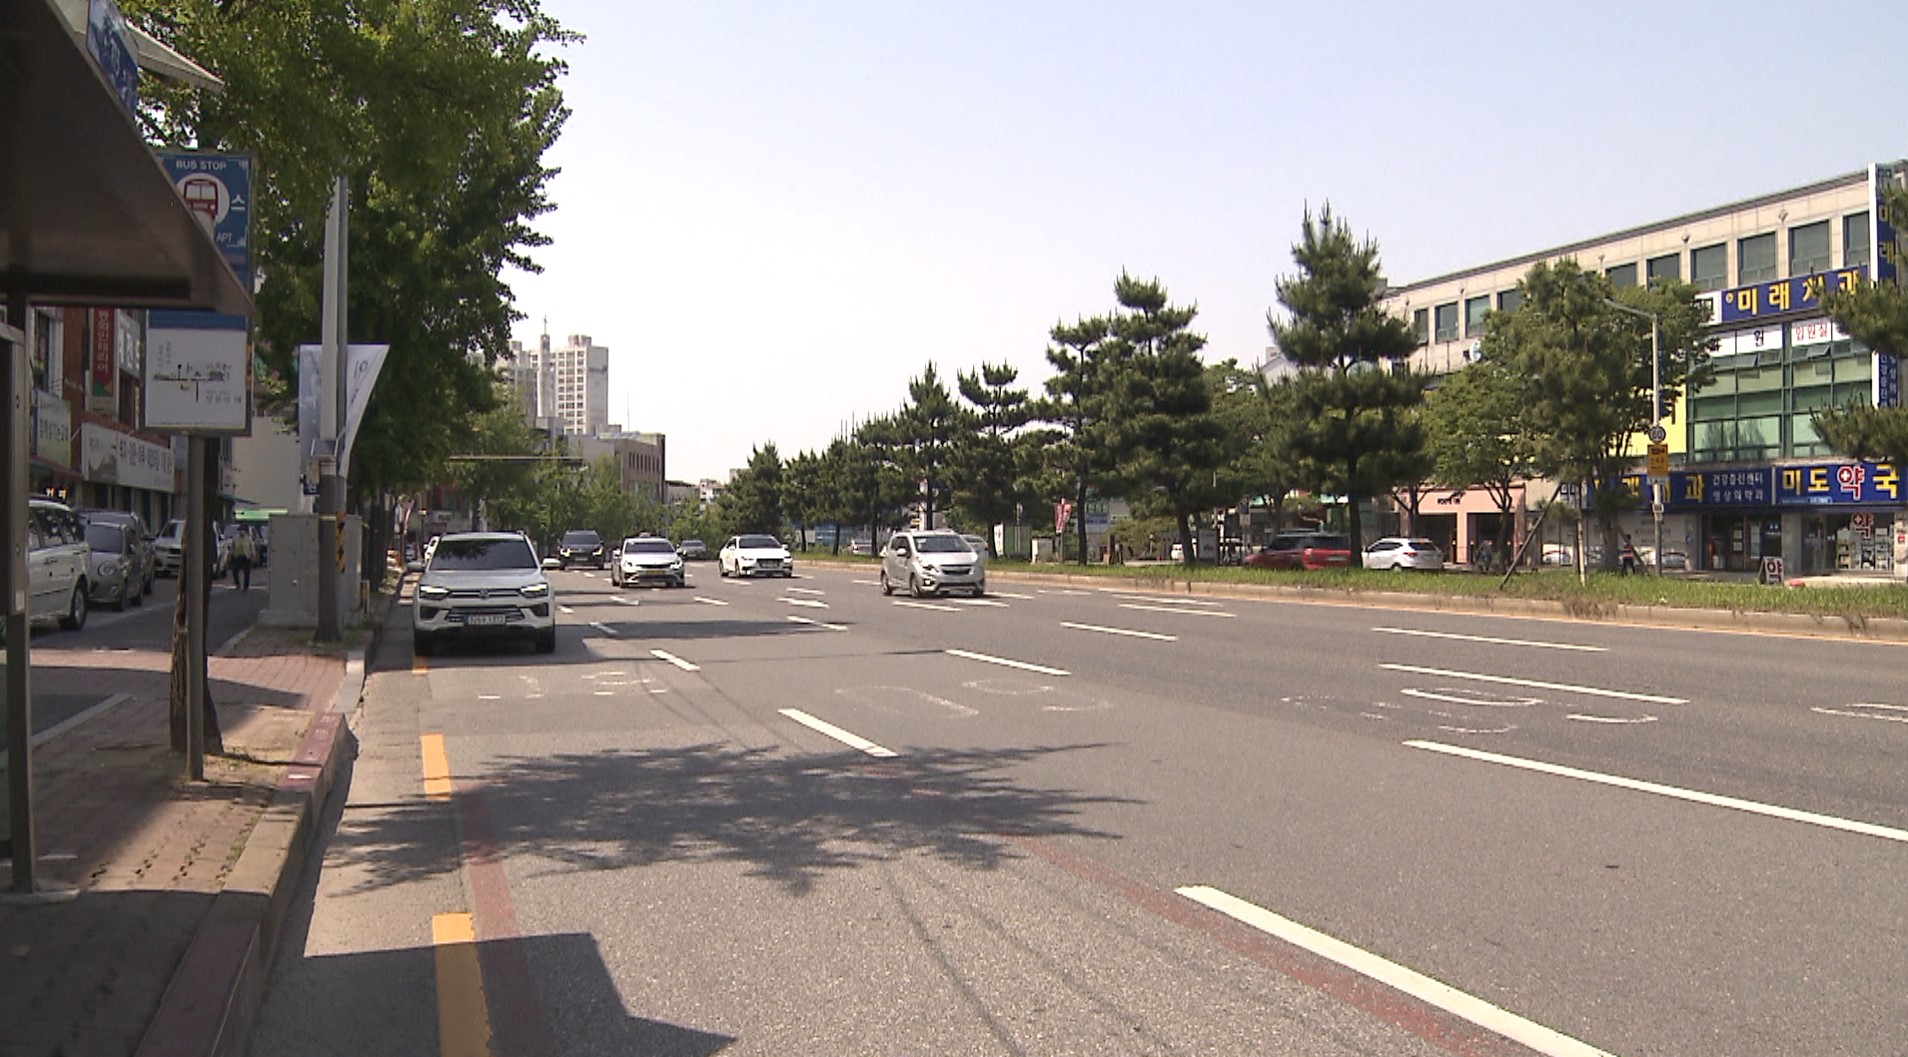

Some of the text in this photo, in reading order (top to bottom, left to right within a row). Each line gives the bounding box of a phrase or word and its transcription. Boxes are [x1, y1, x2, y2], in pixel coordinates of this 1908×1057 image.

[176, 160, 227, 170] BUS STOP
[1782, 463, 1900, 501] 미도약국
[1852, 512, 1874, 541] 약
